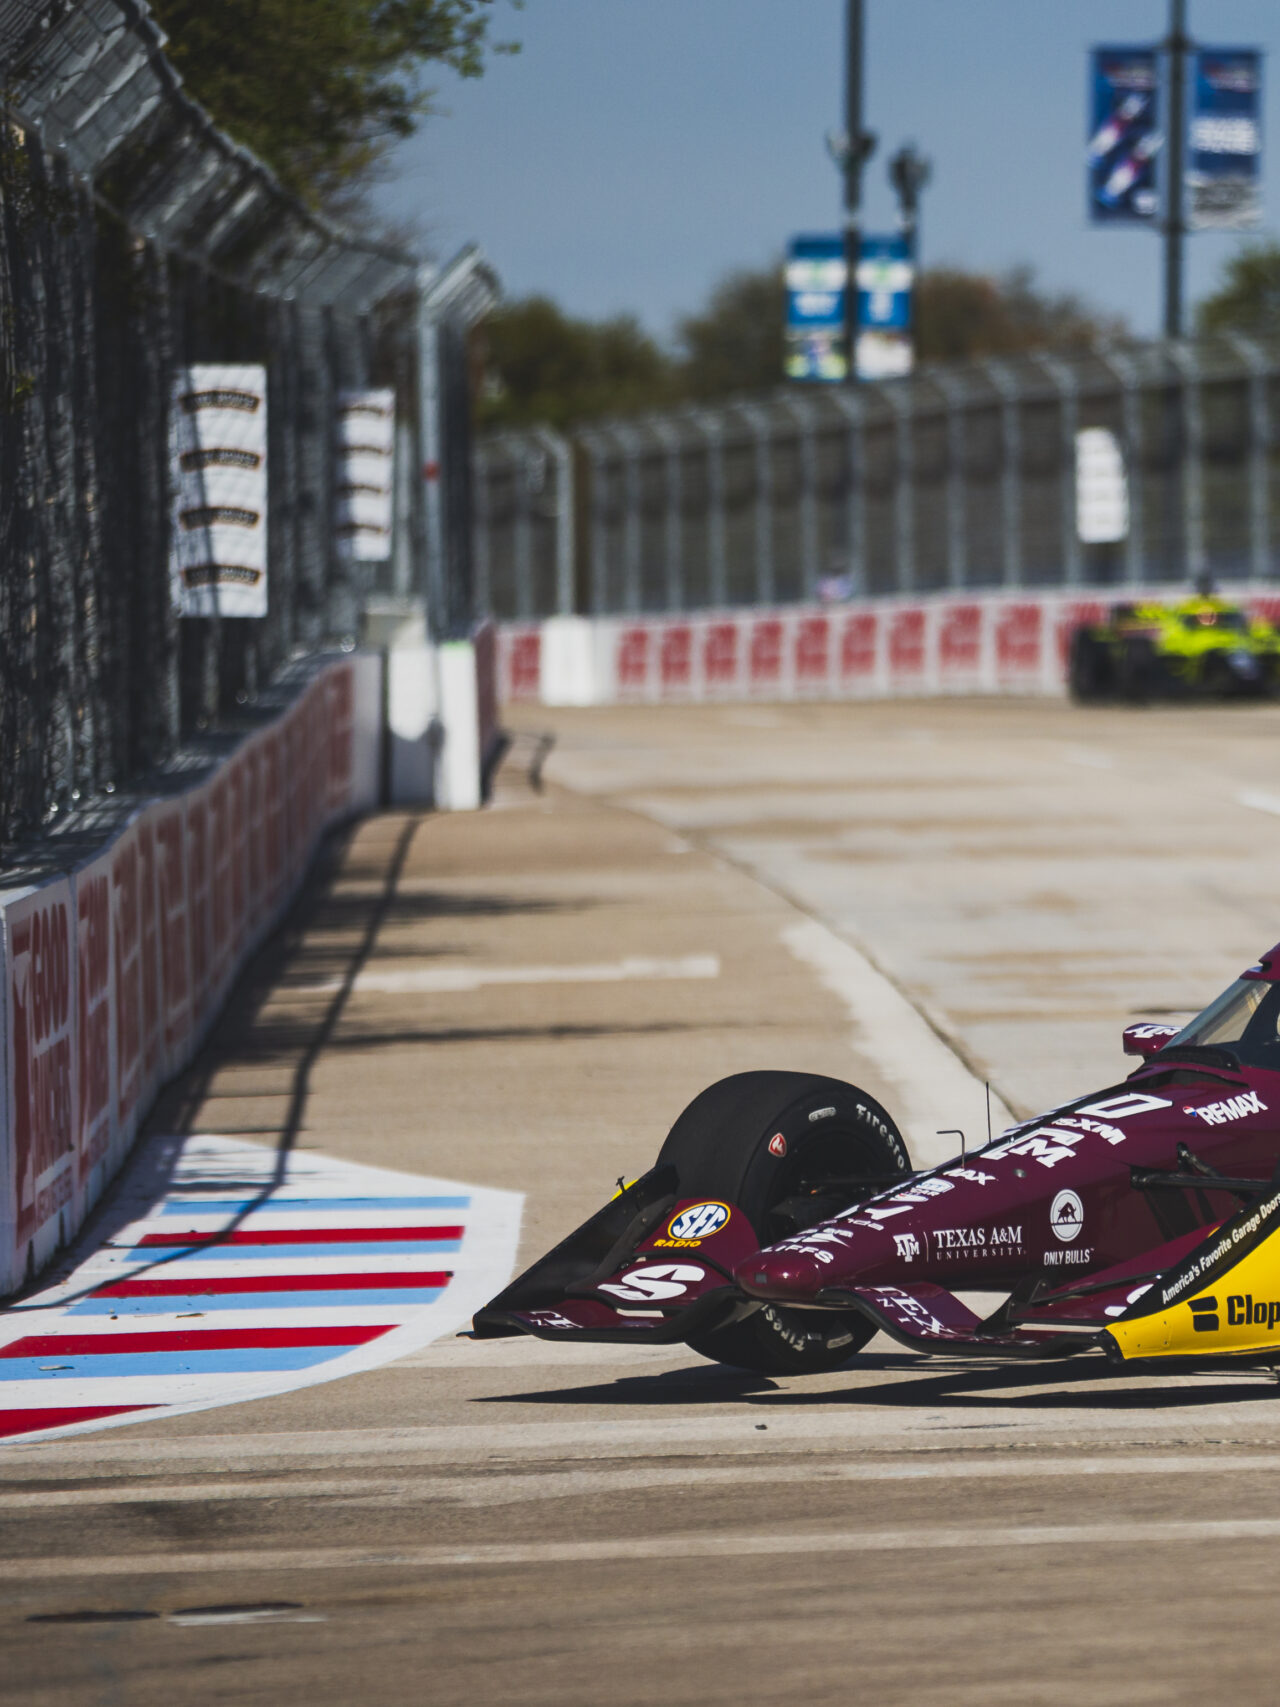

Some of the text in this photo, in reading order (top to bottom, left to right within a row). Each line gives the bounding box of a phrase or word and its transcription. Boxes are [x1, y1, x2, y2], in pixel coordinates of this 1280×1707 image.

[856, 1104, 905, 1168] Firesto
[672, 1205, 727, 1239] SEC
[654, 1239, 702, 1248] RADIO
[933, 1226, 1022, 1248] TEXAS A&M
[937, 1247, 1023, 1261] UNIVERSITY
[1044, 1249, 1090, 1266] ONLY BULLS
[1162, 1266, 1200, 1304] America's
[1199, 1238, 1232, 1272] Favorite
[1231, 1213, 1261, 1243] Garage
